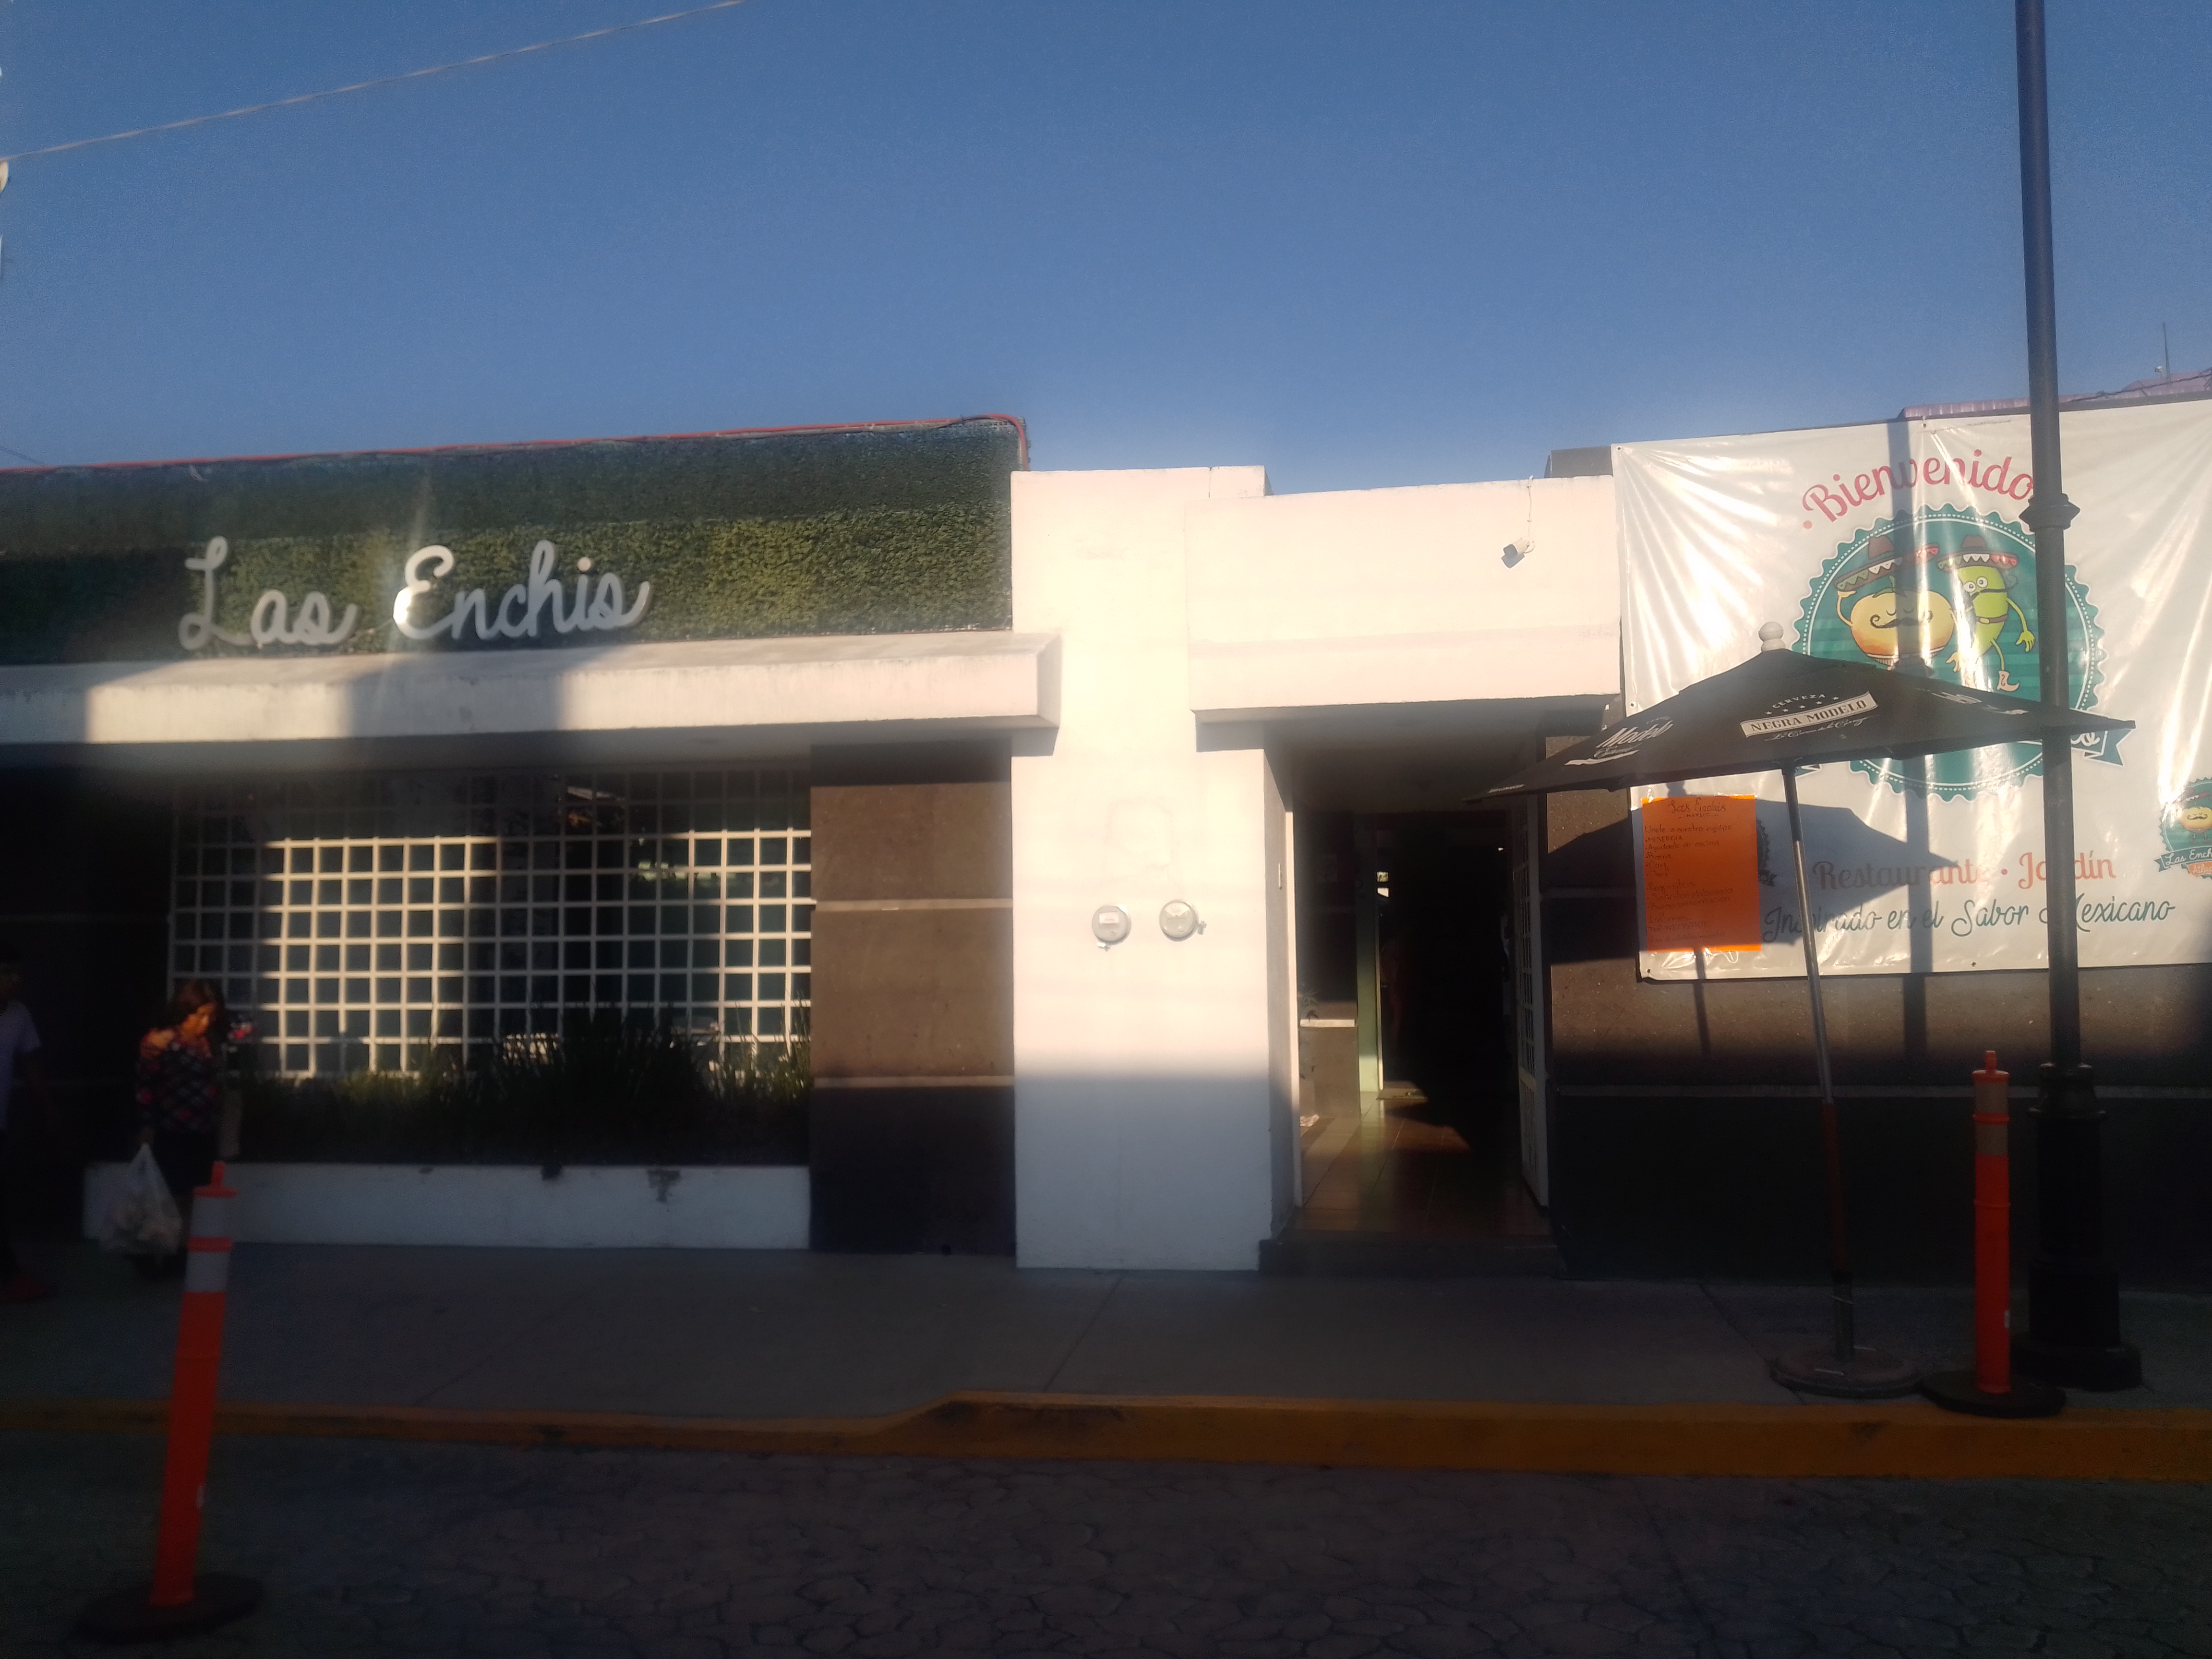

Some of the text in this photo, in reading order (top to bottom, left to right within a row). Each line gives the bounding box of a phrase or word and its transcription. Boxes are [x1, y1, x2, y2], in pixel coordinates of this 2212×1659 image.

[179, 536, 651, 650] Las Enchis
[1750, 699, 1867, 732] NEGRA MODELO
[1772, 693, 1826, 709] CERVEZA
[1595, 720, 1674, 748] Modelo
[2165, 853, 2187, 866] Las
[1887, 909, 1918, 930] en
[1922, 901, 1944, 929] el
[1951, 898, 2029, 937] Sabor
